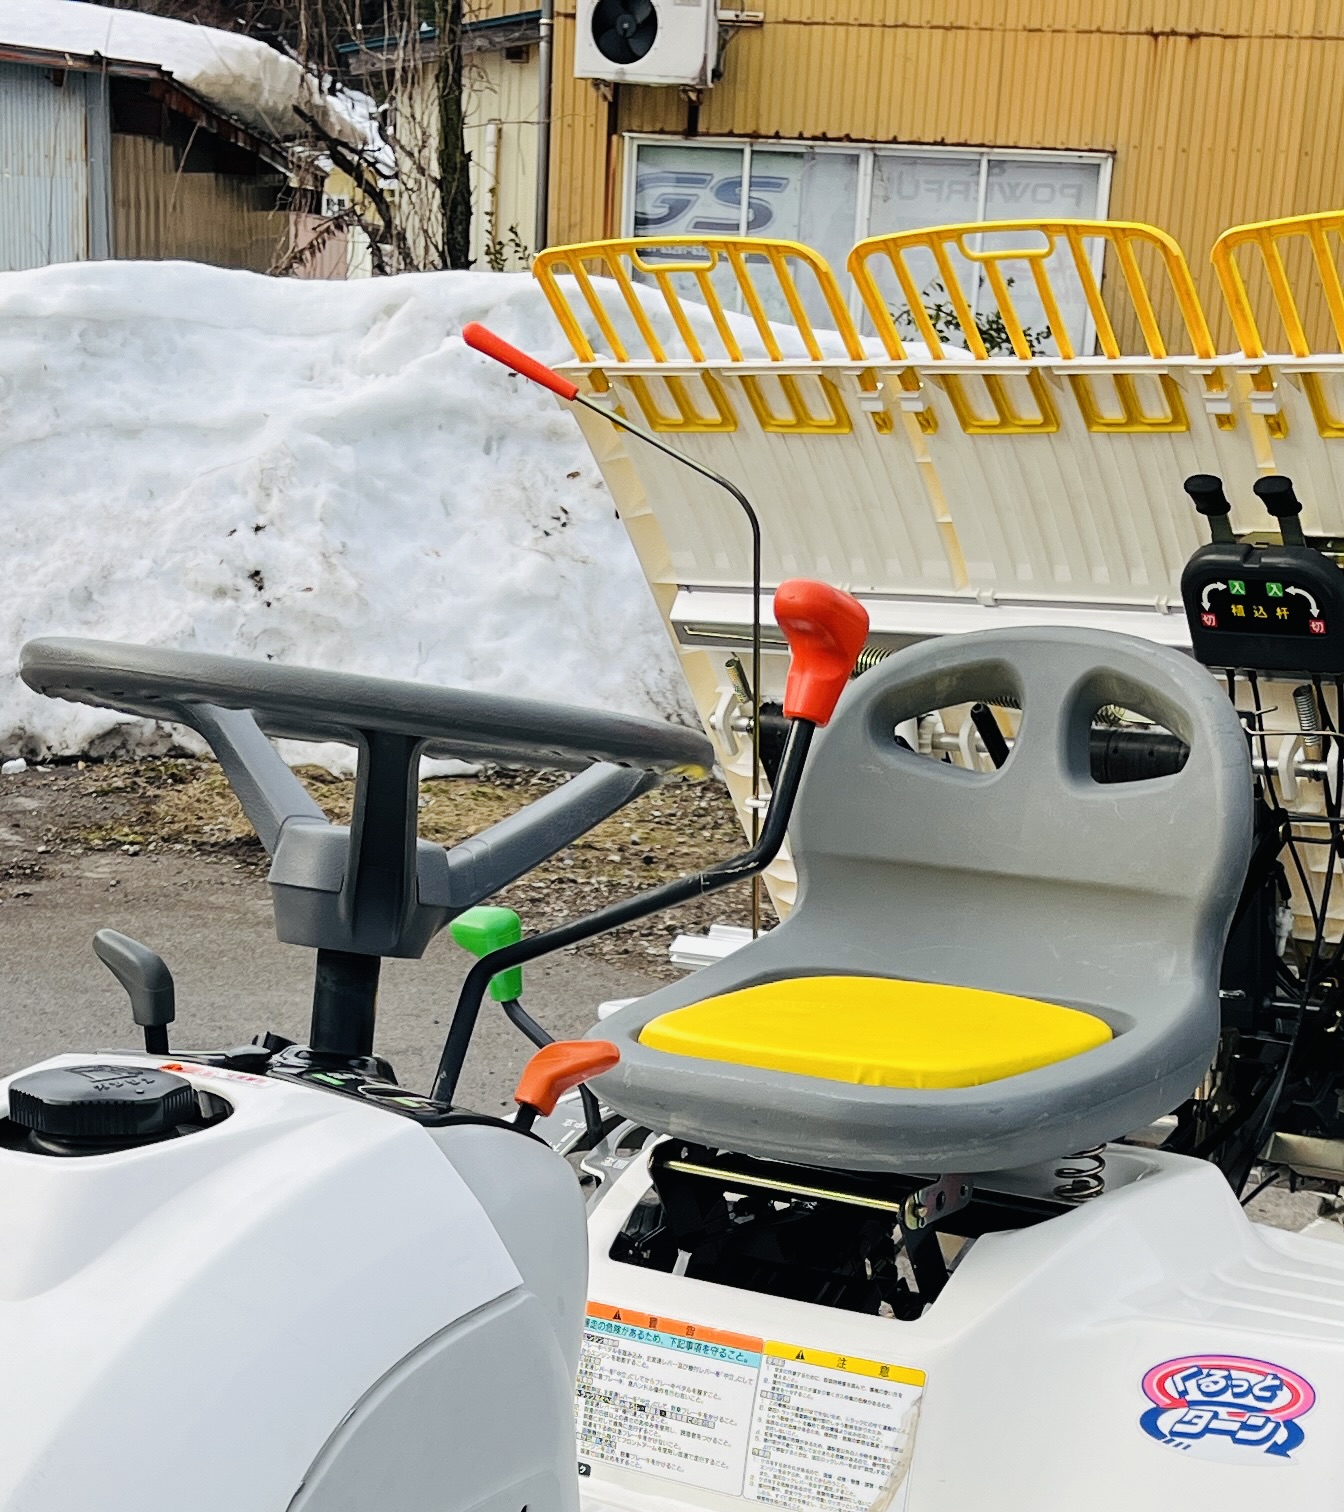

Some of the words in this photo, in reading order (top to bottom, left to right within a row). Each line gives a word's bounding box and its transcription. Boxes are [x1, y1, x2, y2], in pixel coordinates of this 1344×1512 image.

[1231, 582, 1245, 595] 入
[1269, 584, 1283, 597] 入
[1171, 1364, 1284, 1403] くるっと
[1168, 1407, 1282, 1446] ターン
